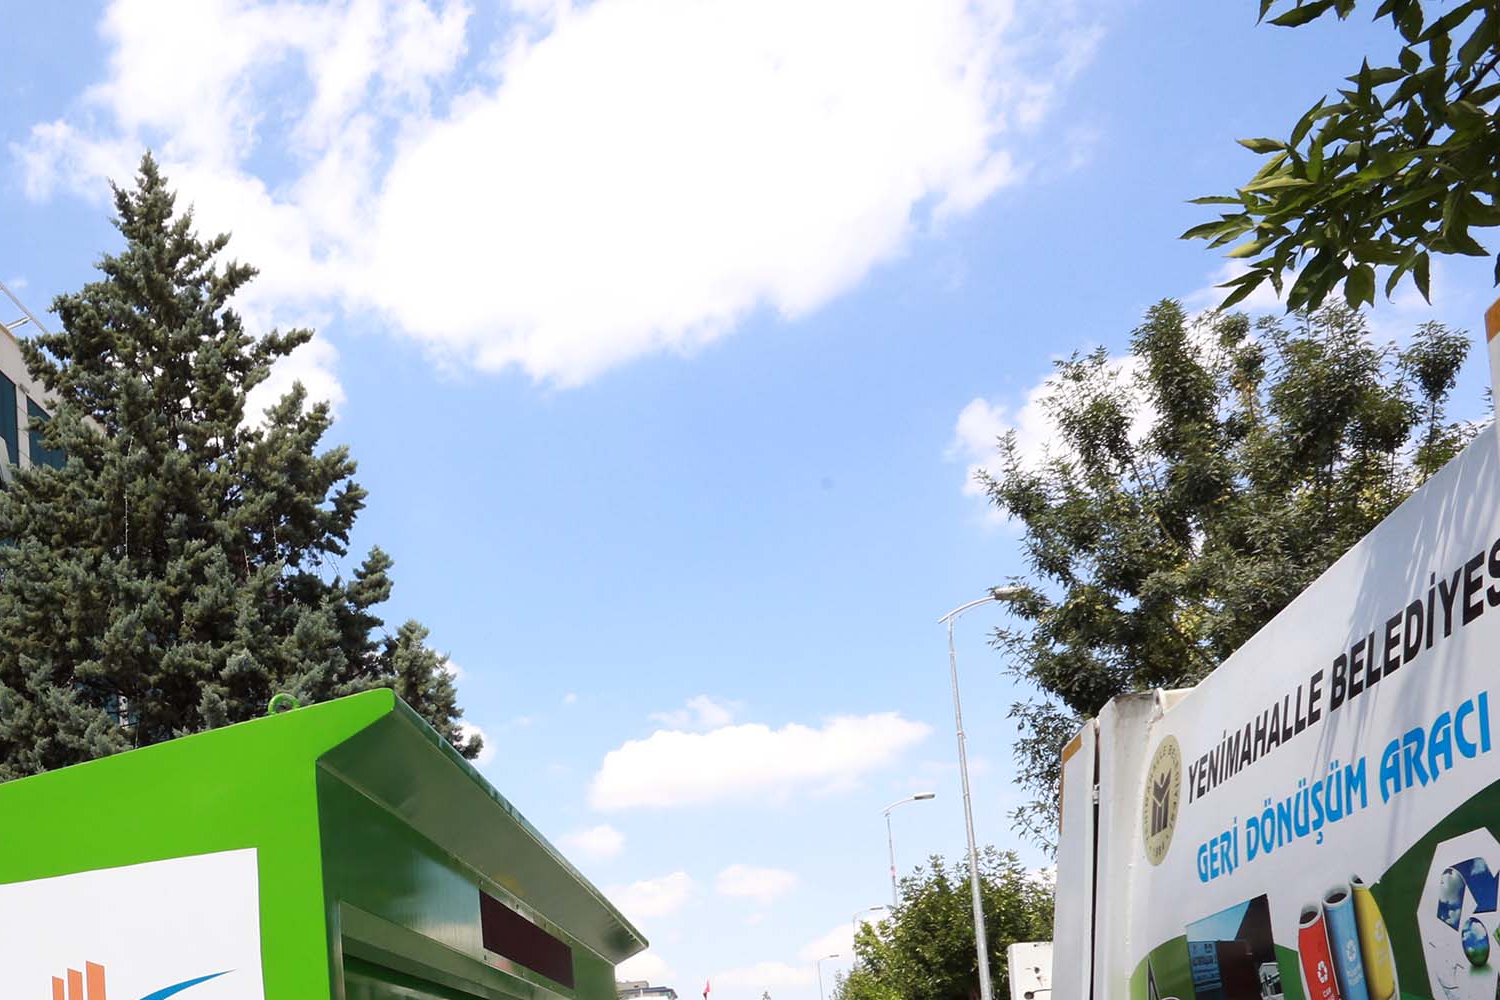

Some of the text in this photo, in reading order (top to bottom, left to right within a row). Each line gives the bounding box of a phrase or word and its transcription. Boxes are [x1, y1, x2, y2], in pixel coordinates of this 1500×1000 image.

[1188, 669, 1324, 804] YENİMAHALLE
[1197, 817, 1239, 884] GERİ
[1246, 756, 1368, 861] DÖNÜŞÜM
[1380, 691, 1491, 804] ARACI
